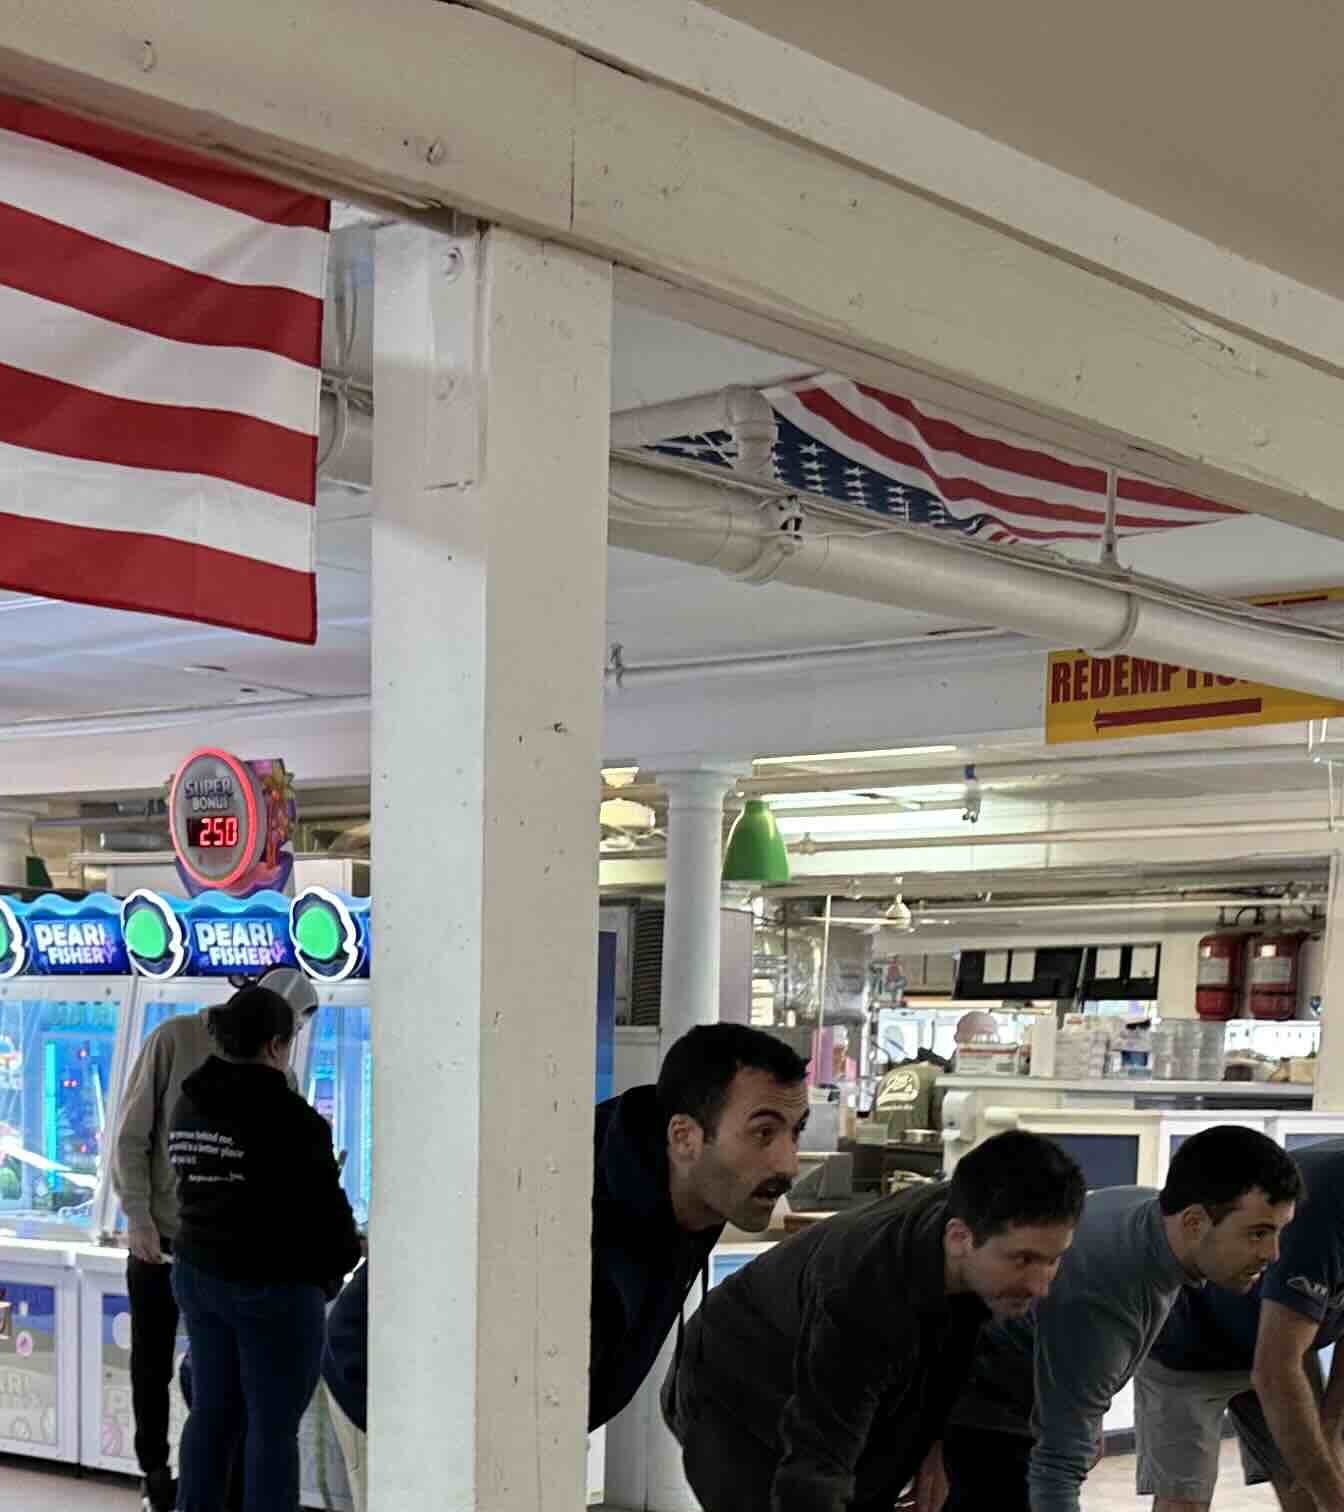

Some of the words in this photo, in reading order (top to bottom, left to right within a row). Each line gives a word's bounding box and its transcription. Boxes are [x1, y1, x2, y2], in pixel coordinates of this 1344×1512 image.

[1050, 655, 1250, 704] REDEMP
[183, 777, 233, 800] SUPER
[199, 817, 238, 847] 250
[33, 922, 105, 952] PEARL
[195, 922, 274, 952] PEARL
[47, 942, 118, 967] FISHERY
[209, 942, 287, 967] FISHERY
